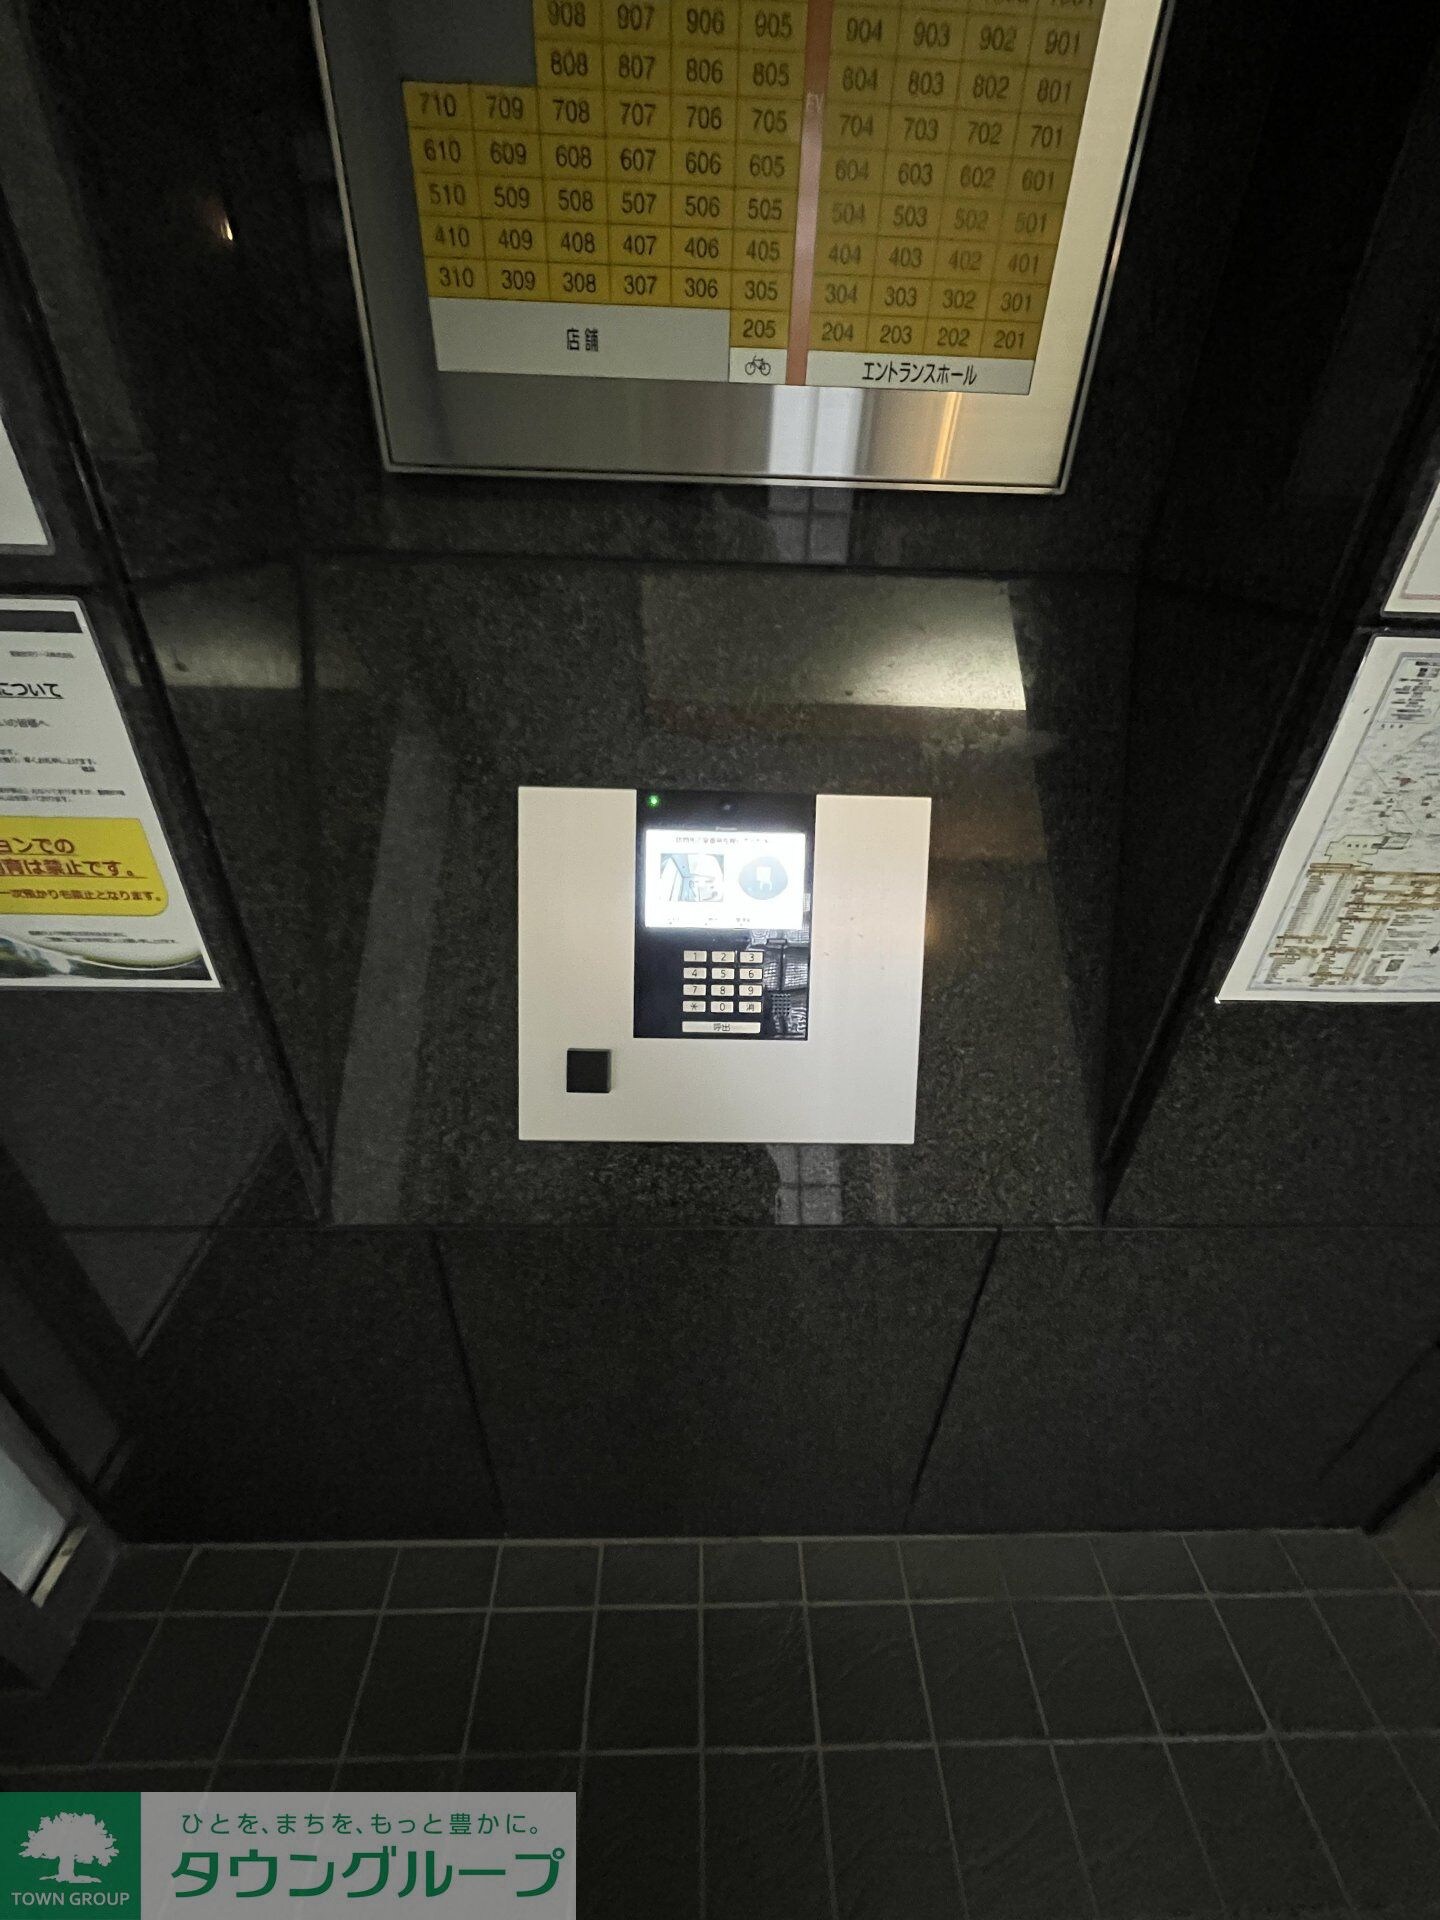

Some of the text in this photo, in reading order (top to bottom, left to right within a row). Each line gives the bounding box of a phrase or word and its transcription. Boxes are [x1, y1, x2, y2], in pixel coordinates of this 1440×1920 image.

[549, 2, 586, 28] 908
[618, 4, 655, 30] 907
[687, 9, 724, 34] 906
[755, 12, 792, 38] 905
[846, 18, 883, 43] 904
[914, 21, 950, 48] 903
[1044, 30, 1080, 55] 901
[551, 51, 1072, 105] 808 807 806 805 804 803 802 801
[419, 93, 1063, 148] 710 709 708 707 706 705 704 703 702 701
[424, 139, 1055, 192] 610 609 608 607 606 605 604 603 602 601
[429, 184, 1047, 234] 510 509 508 507 506 505 504 503 502 501
[435, 226, 1039, 275] 410 409 408 407 406 405 404 403 402 401
[439, 267, 1032, 313] 310 309 308 307 306 305 304 303 302 301
[567, 328, 599, 352] 店舗
[743, 319, 1025, 350] 205 204 203 202 201
[862, 360, 977, 386] エントランスホール
[721, 953, 726, 961] 2
[692, 969, 697, 977] 4
[721, 970, 726, 978] 5
[749, 970, 754, 978] 6
[720, 986, 726, 994] 8
[748, 986, 754, 995] 9
[720, 1003, 725, 1011] 0
[713, 1023, 730, 1031] 呼出
